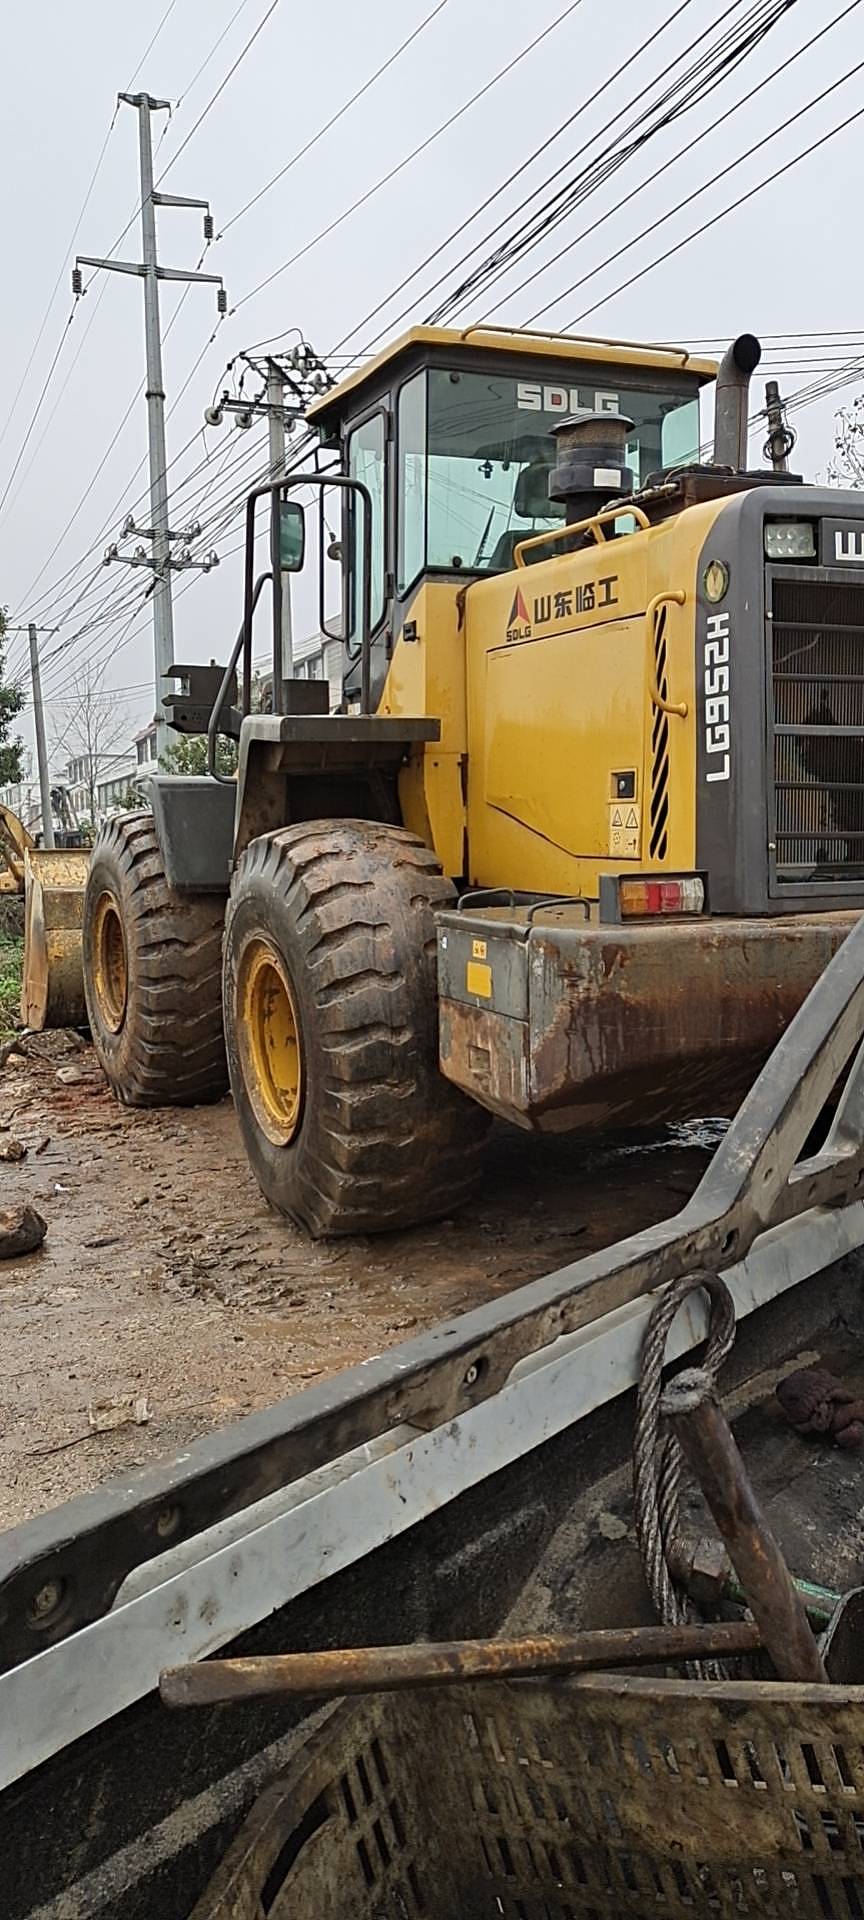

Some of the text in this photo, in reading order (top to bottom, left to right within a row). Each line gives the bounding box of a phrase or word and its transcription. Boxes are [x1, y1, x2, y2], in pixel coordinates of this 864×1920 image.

[517, 383, 619, 414] SDLG
[534, 575, 618, 625] 山东临工
[506, 625, 532, 642] SDLG
[705, 612, 730, 782] LG952H
